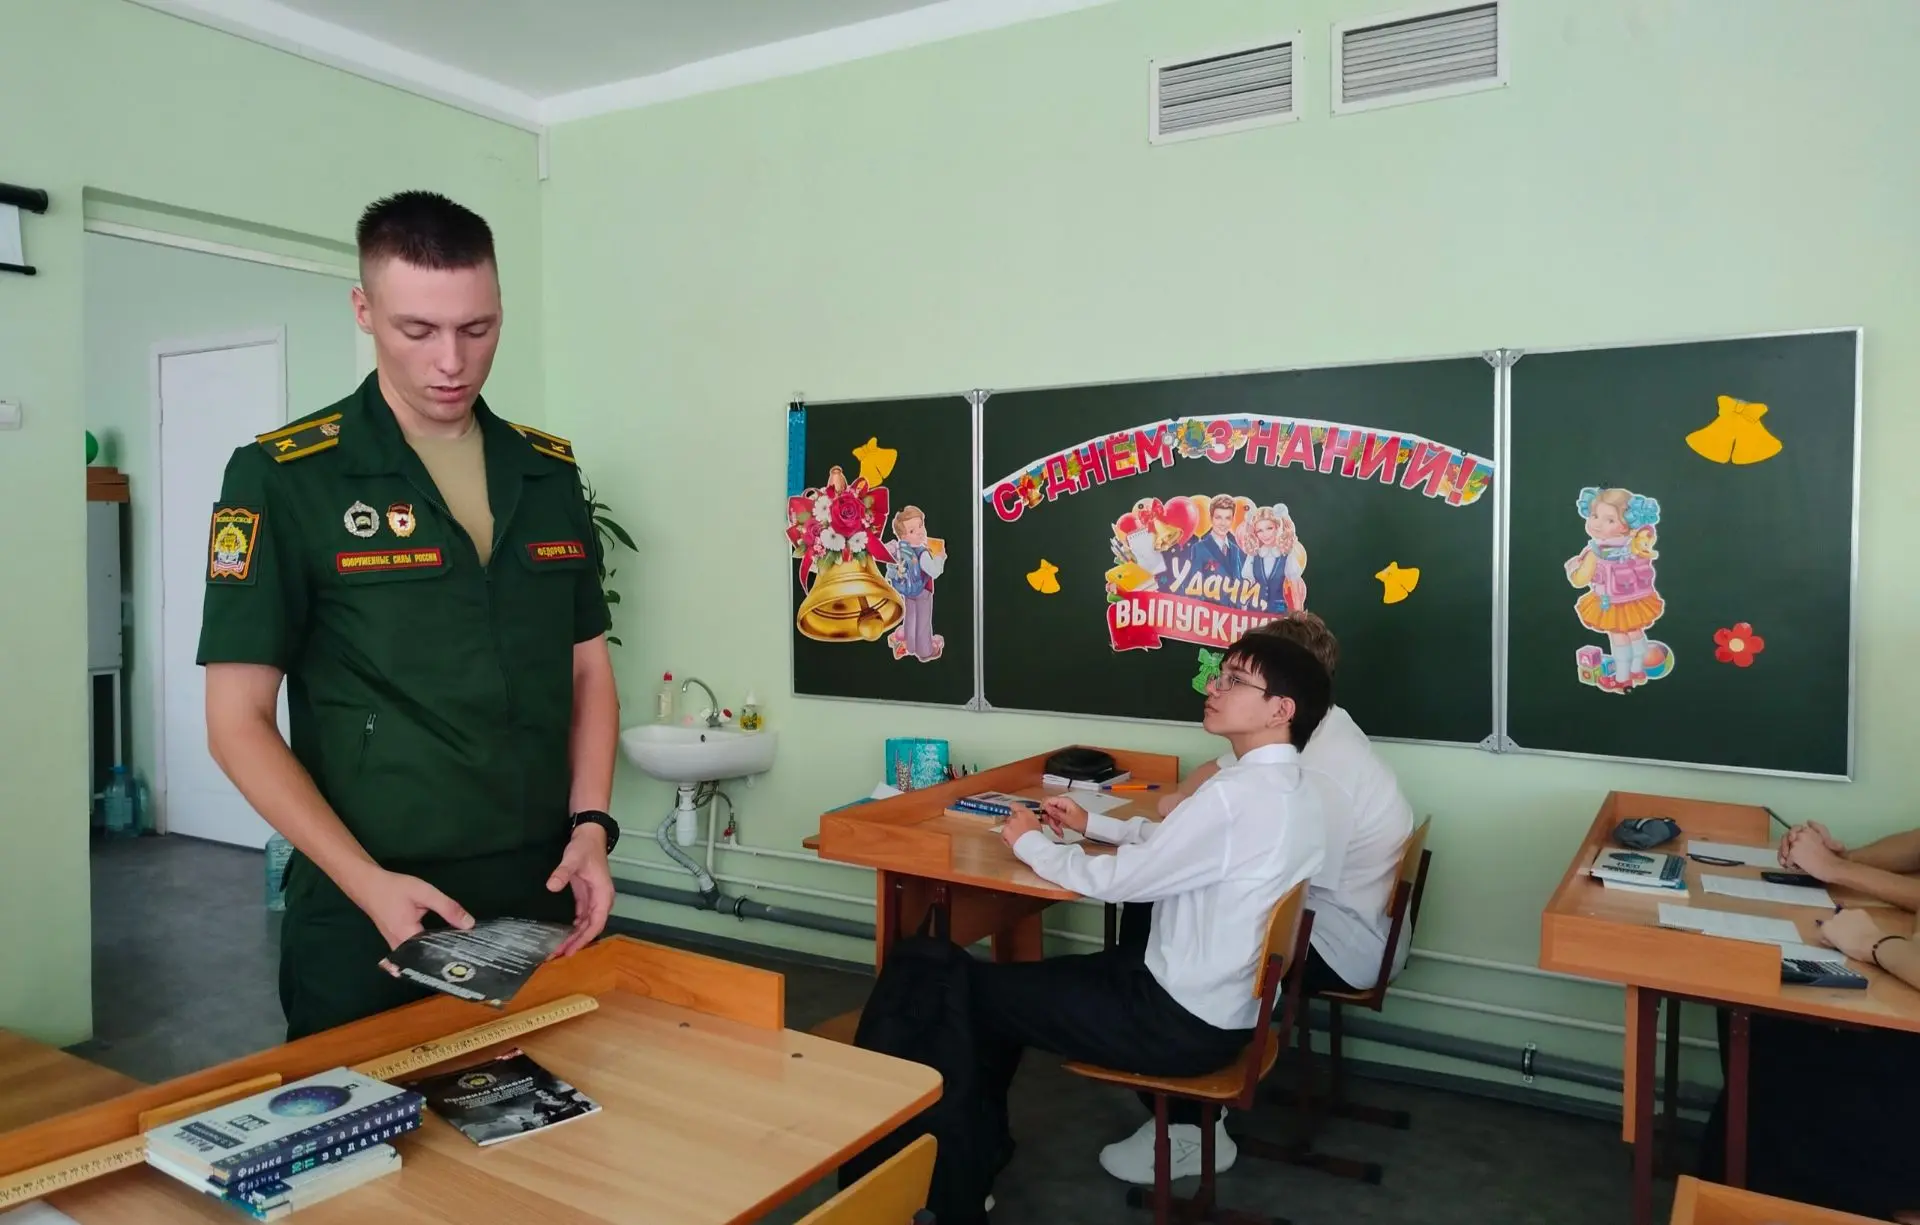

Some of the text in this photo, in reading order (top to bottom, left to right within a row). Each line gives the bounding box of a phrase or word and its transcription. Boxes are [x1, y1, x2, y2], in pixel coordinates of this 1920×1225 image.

[993, 419, 1477, 522] С ДНЁМ ЗНАНИЙ!
[341, 552, 438, 568] ВООРУЖЕННЫЕ СИЛЫ РОССИИ
[1169, 556, 1268, 611] Удачи,
[238, 1156, 282, 1177] Физика
